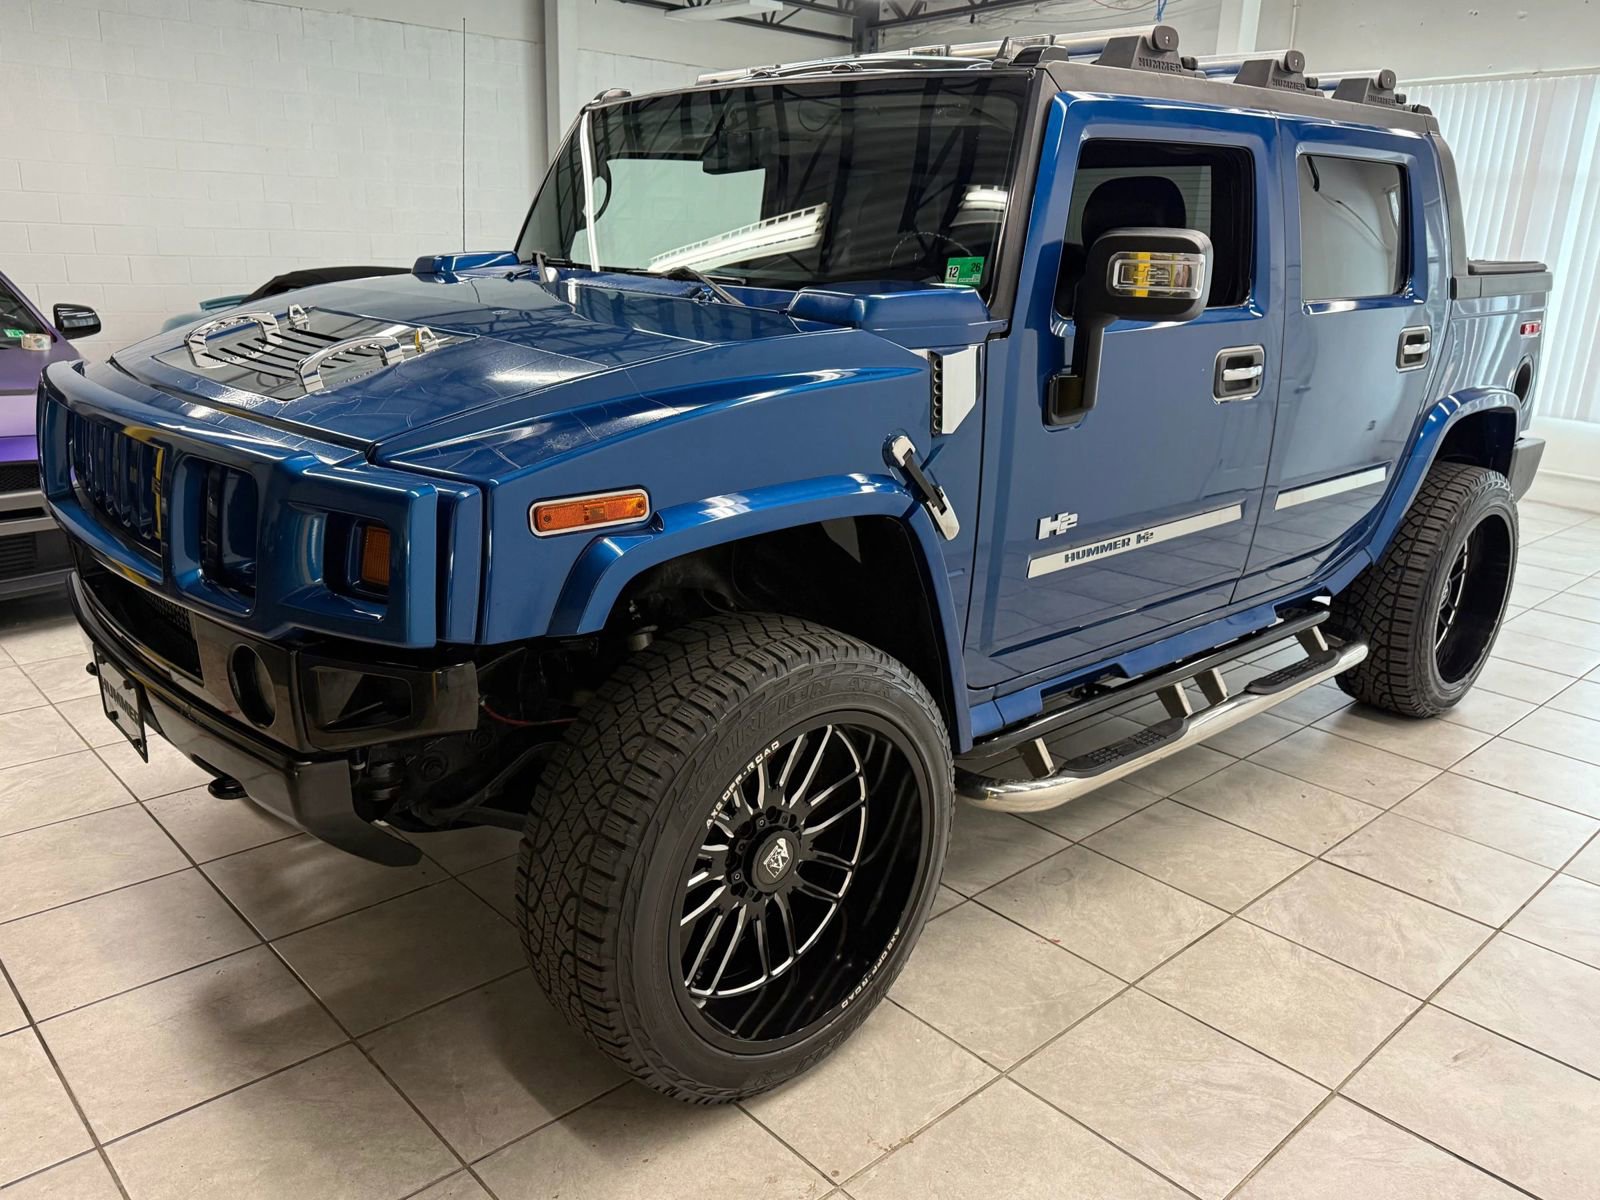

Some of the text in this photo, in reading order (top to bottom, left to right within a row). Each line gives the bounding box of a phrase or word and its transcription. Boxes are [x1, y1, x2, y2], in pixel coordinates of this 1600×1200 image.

[1138, 57, 1182, 73] HUMMER
[948, 266, 959, 278] 12
[1035, 512, 1078, 541] H2
[1064, 531, 1154, 563] HUMMER H2
